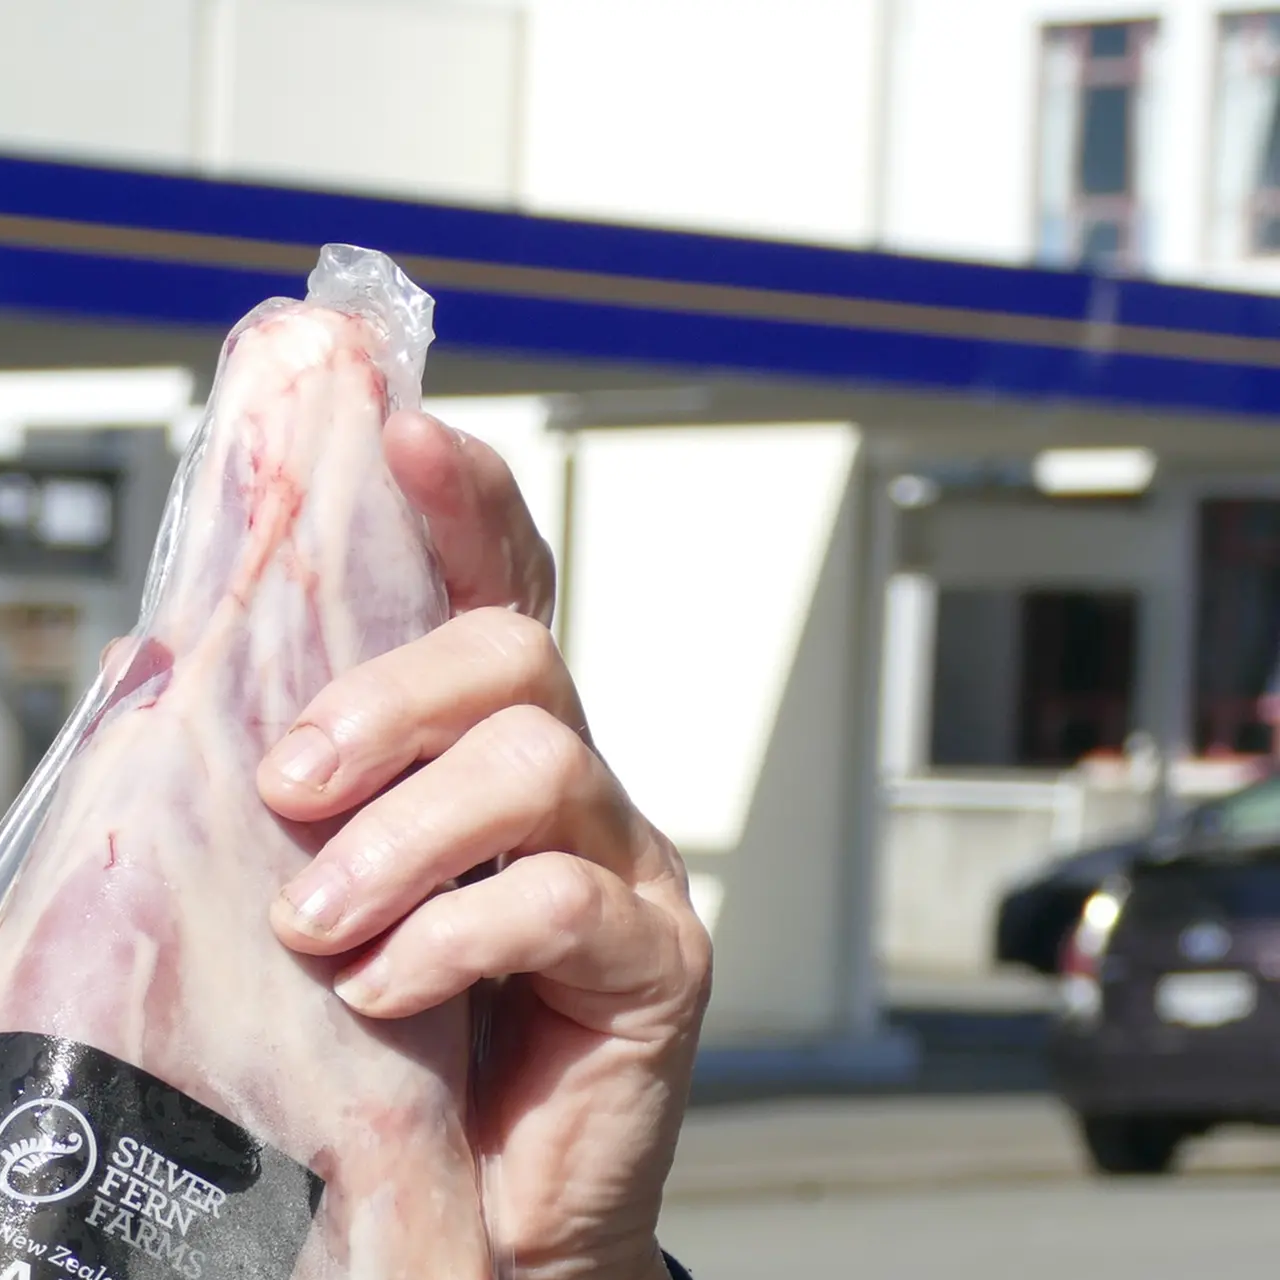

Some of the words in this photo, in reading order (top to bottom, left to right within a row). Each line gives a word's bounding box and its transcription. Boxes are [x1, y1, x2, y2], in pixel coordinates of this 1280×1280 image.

[97, 1164, 197, 1237] FERN
[112, 1136, 227, 1219] SILVER
[85, 1195, 206, 1280] FARMS
